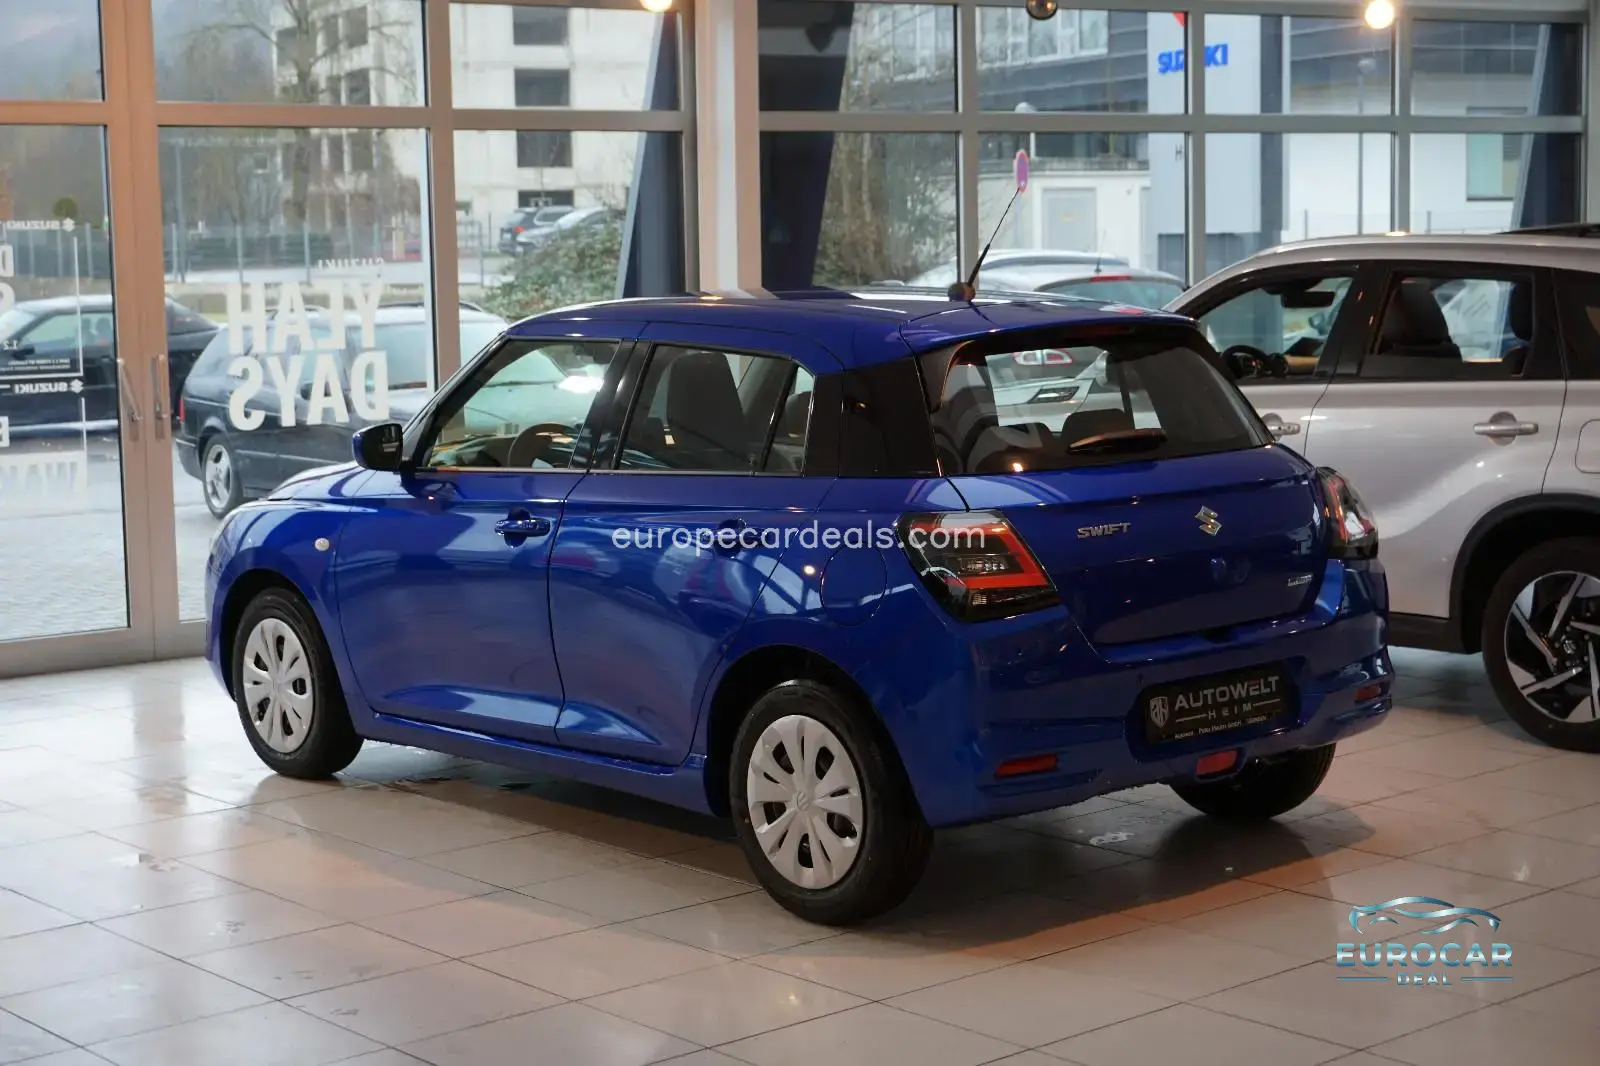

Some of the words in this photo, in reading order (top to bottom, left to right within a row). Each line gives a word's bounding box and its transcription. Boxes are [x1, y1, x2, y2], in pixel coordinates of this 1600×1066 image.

[1158, 43, 1228, 74] SUKI
[1077, 522, 1131, 539] SWIFT
[1174, 676, 1279, 711] AUTOWELT
[1208, 702, 1252, 720] HEIM
